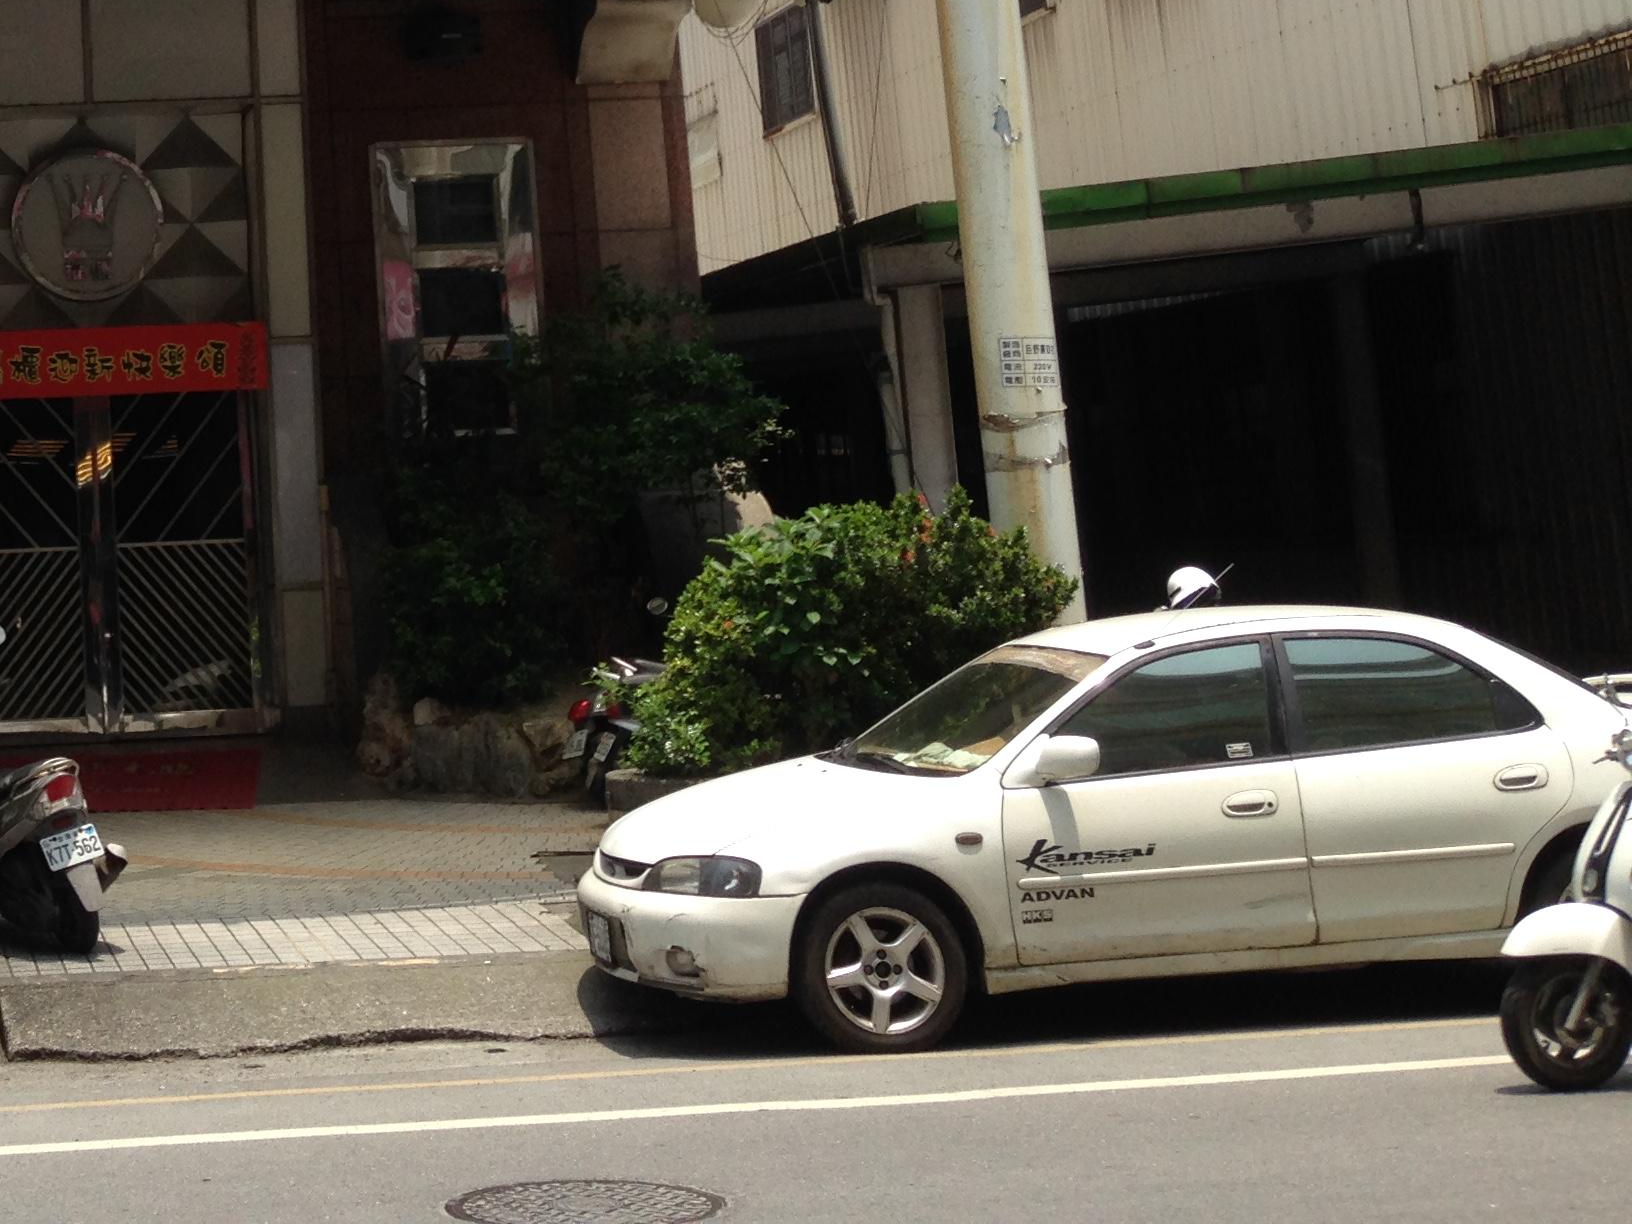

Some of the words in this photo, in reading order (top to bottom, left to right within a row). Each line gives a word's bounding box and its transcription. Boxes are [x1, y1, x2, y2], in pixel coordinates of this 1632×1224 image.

[46, 835, 102, 866] K7T-562
[1016, 839, 1157, 875] Kansai
[1021, 887, 1096, 903] ADVAN
